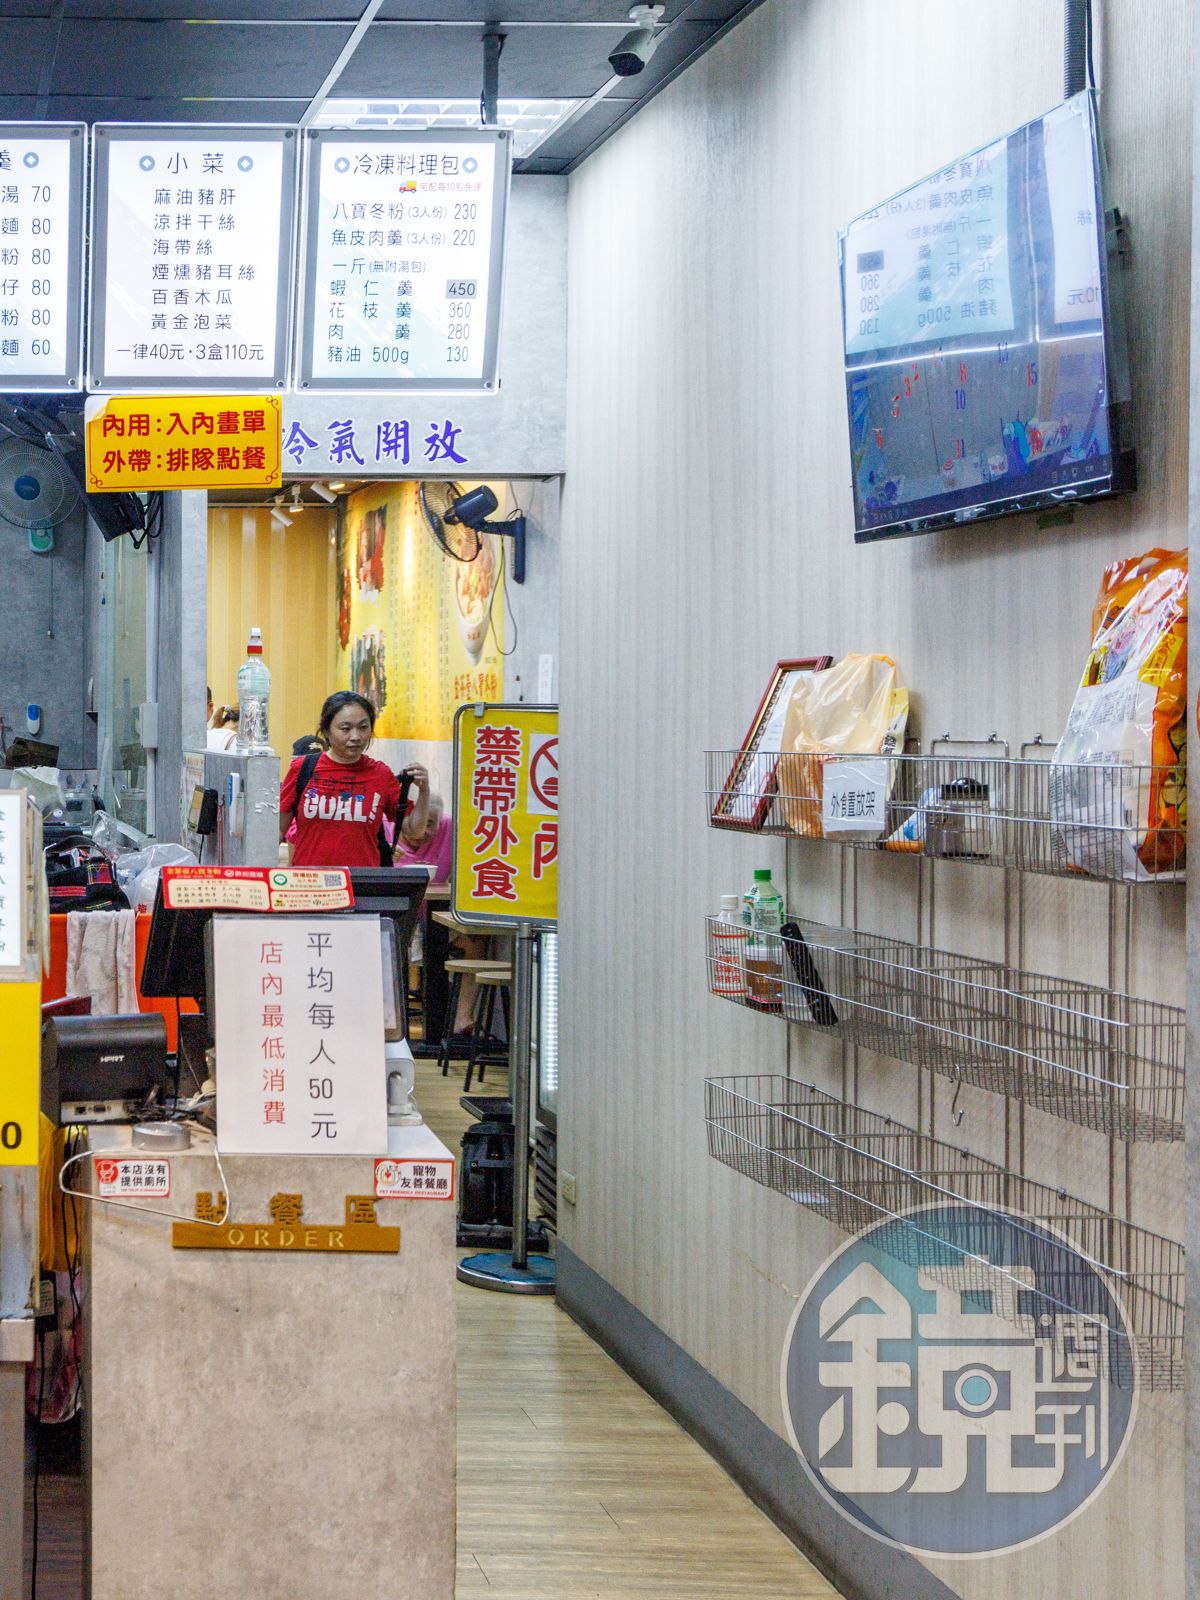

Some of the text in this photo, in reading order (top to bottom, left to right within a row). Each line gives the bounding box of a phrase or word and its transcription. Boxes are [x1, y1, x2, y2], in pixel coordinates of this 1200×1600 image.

[168, 152, 223, 174] 小菜
[354, 154, 459, 175] 冷凍料理包
[32, 186, 50, 202] 70
[155, 188, 235, 205] 麻油豬肝
[454, 204, 476, 219] 230
[32, 218, 50, 234] 80
[155, 214, 234, 230] 涼拌干絲
[453, 230, 475, 245] 220
[154, 239, 212, 255] 海帶絲
[32, 249, 50, 264] 80
[153, 264, 254, 280] 煙燻豬耳絲
[32, 279, 50, 295] 80
[331, 280, 476, 297] 蝦仁羹 450
[152, 289, 232, 304] 百香木瓜
[32, 309, 50, 325] 80
[330, 302, 471, 318] 花枝羹 360
[152, 314, 231, 329] 黃金泡菜
[329, 323, 469, 339] 肉羹 280
[32, 339, 50, 355] 60
[328, 346, 468, 364] 豬油 500g 130
[283, 418, 467, 466] 冷氣開放
[831, 789, 875, 818] 外食置放架
[472, 725, 520, 900] 禁帶外食
[260, 941, 286, 1126] 店內最低消費
[306, 932, 338, 1139] 平均每人50元
[121, 1164, 166, 1175] 本店沒有
[413, 1164, 436, 1176] 寵物
[121, 1176, 166, 1187] 提供廁所
[400, 1177, 448, 1189] 友善餐廳
[194, 1191, 380, 1226] 點餐區
[227, 1228, 346, 1248] ORDER
